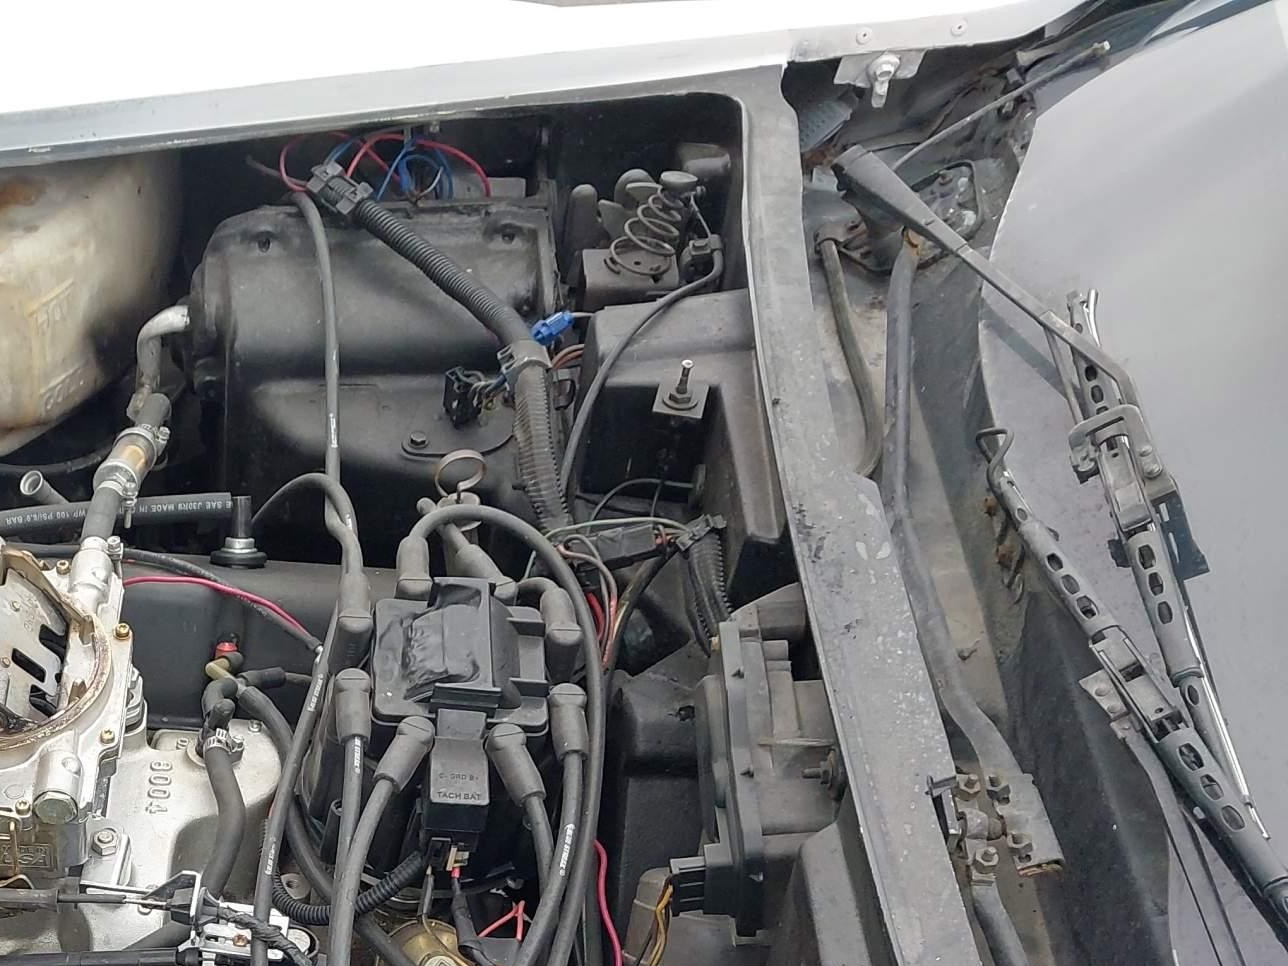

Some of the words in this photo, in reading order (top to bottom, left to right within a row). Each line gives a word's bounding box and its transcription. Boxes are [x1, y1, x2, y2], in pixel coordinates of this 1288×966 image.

[146, 760, 173, 815] 8004
[437, 791, 462, 800] TACH
[463, 792, 481, 801] BAT
